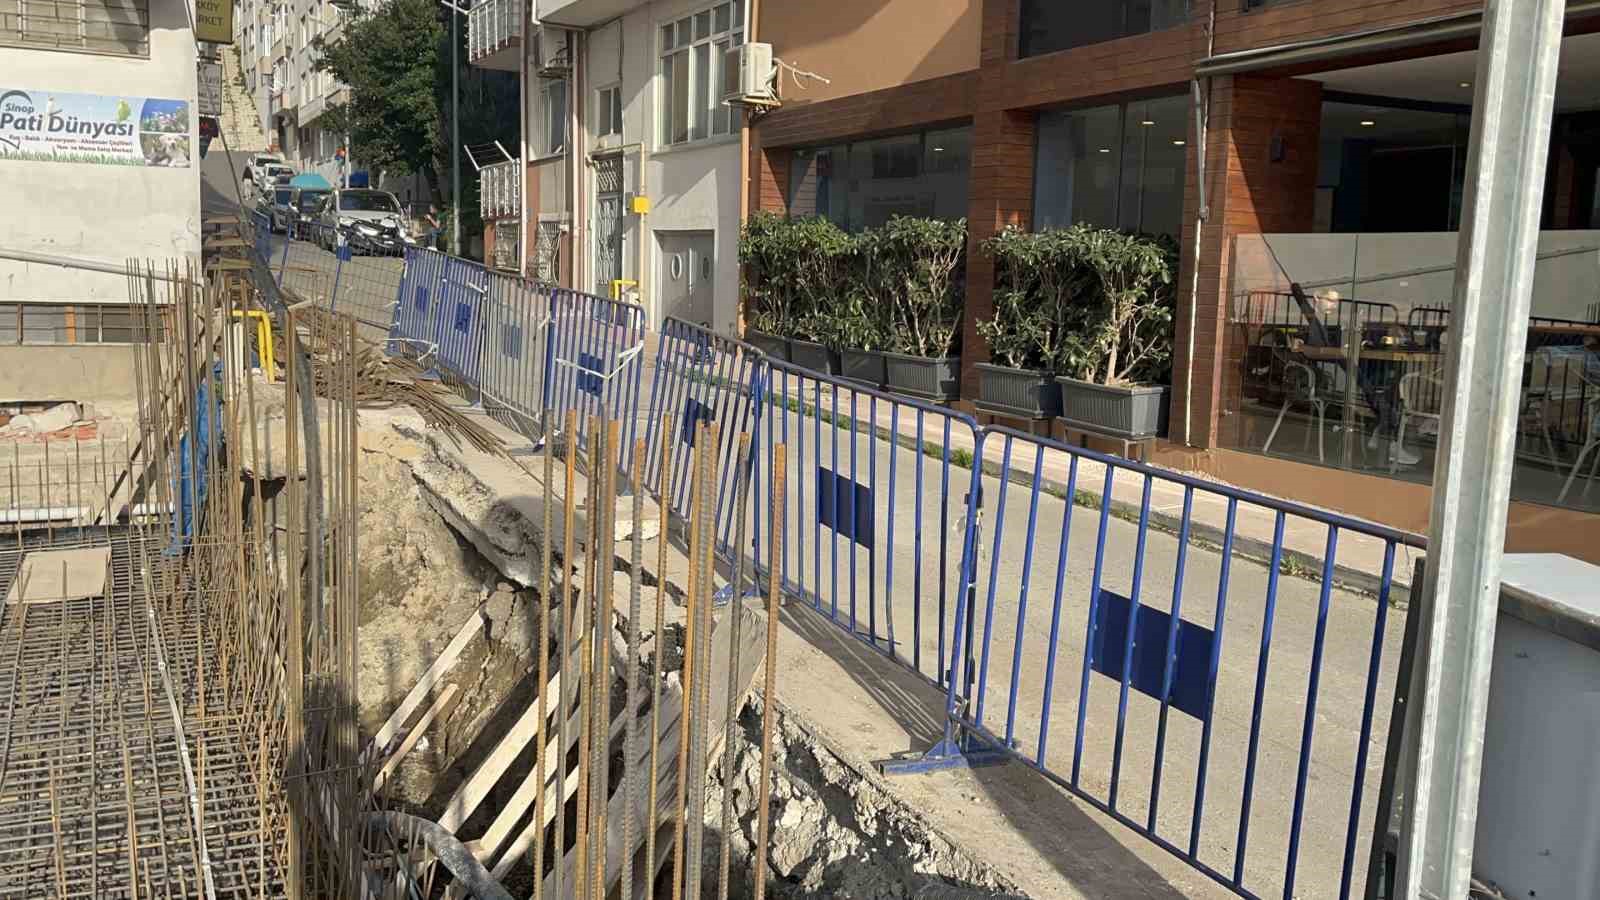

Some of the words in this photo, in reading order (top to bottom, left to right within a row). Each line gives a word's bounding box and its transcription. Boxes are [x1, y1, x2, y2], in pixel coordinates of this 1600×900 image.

[5, 103, 35, 114] Sinop
[1, 113, 42, 131] Pati
[48, 115, 134, 139] Dünyası
